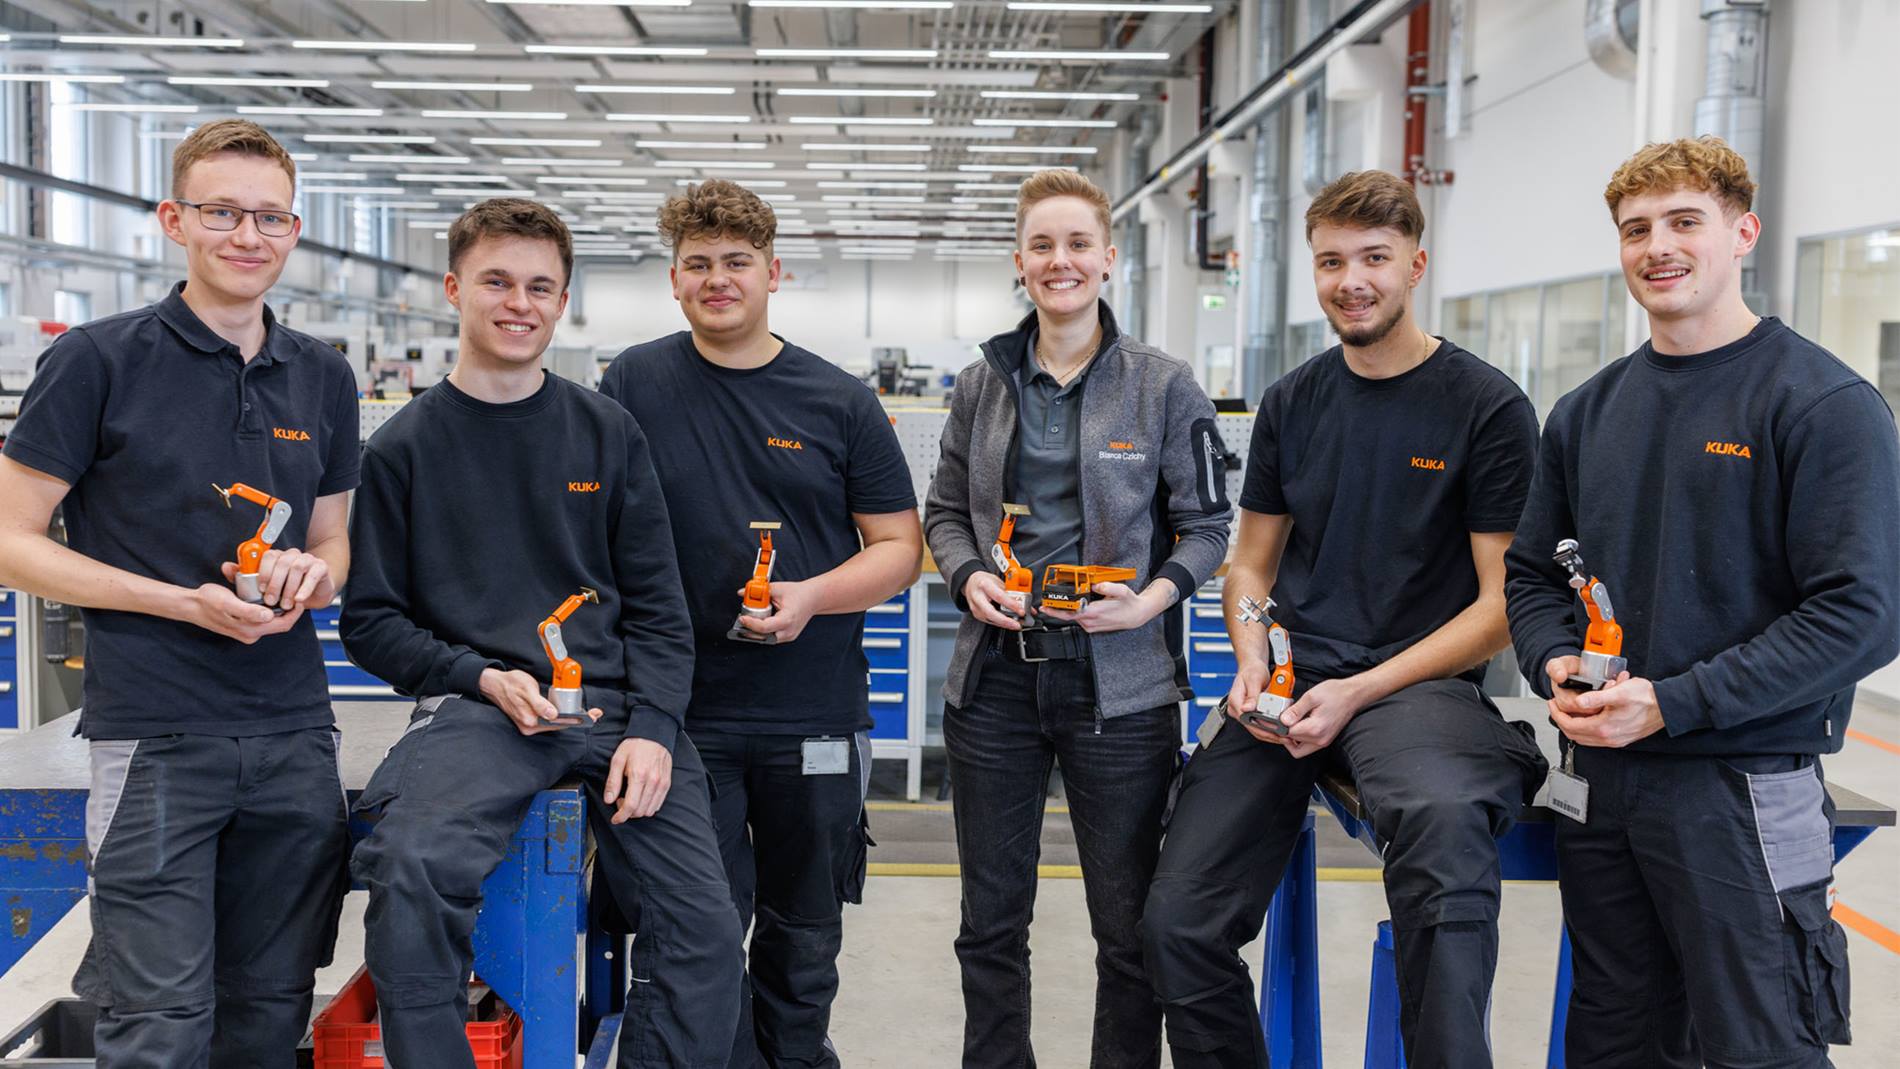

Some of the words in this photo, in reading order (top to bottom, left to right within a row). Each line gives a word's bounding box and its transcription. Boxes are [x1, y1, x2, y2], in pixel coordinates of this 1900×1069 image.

[273, 427, 311, 440] KUKA
[768, 437, 802, 449] KUKA
[1109, 441, 1134, 449] KUKA
[1705, 442, 1751, 458] KUKA
[1411, 457, 1445, 469] KUKA
[568, 481, 601, 492] KUKA
